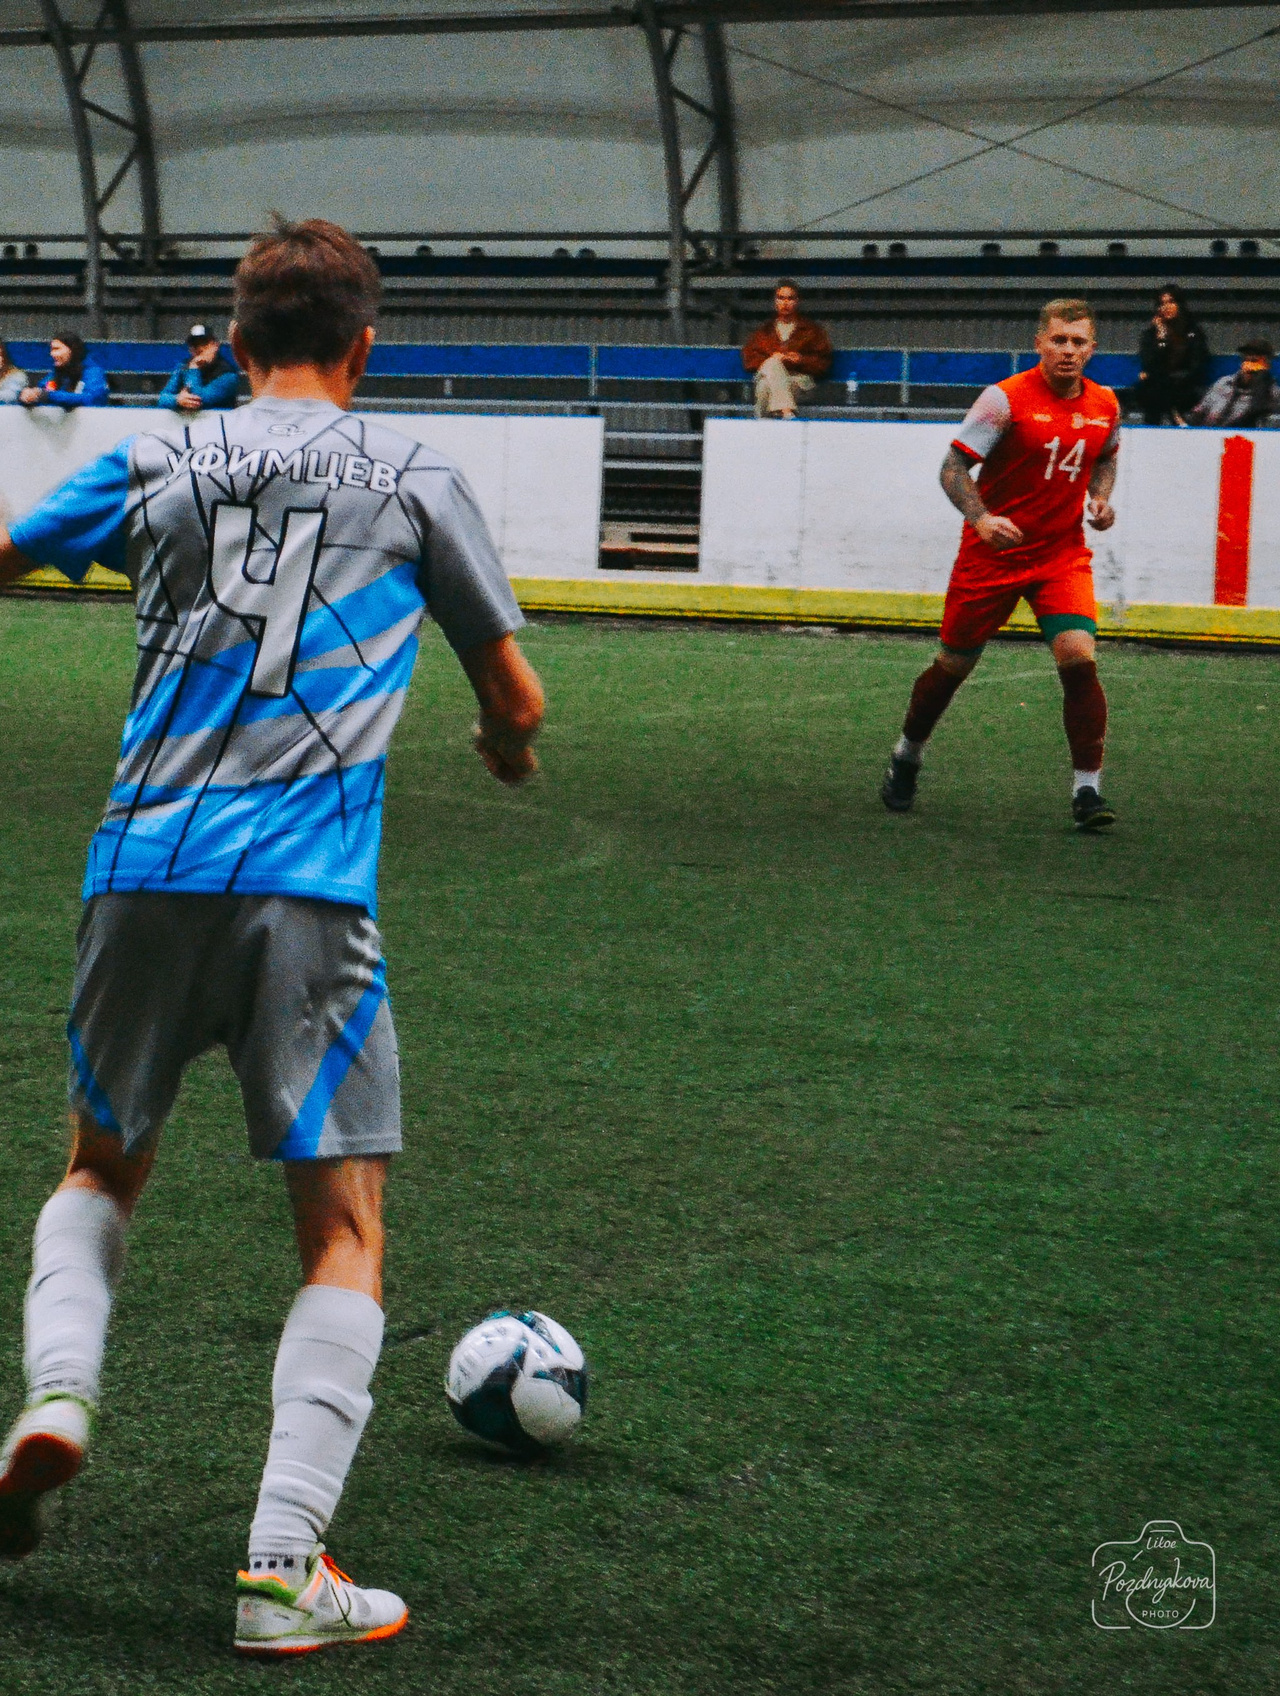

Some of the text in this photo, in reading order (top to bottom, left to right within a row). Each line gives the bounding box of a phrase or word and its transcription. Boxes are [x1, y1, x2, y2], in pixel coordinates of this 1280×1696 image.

[166, 443, 400, 495] УФИМЦЕВ
[1043, 435, 1087, 482] 14
[206, 499, 329, 699] 4
